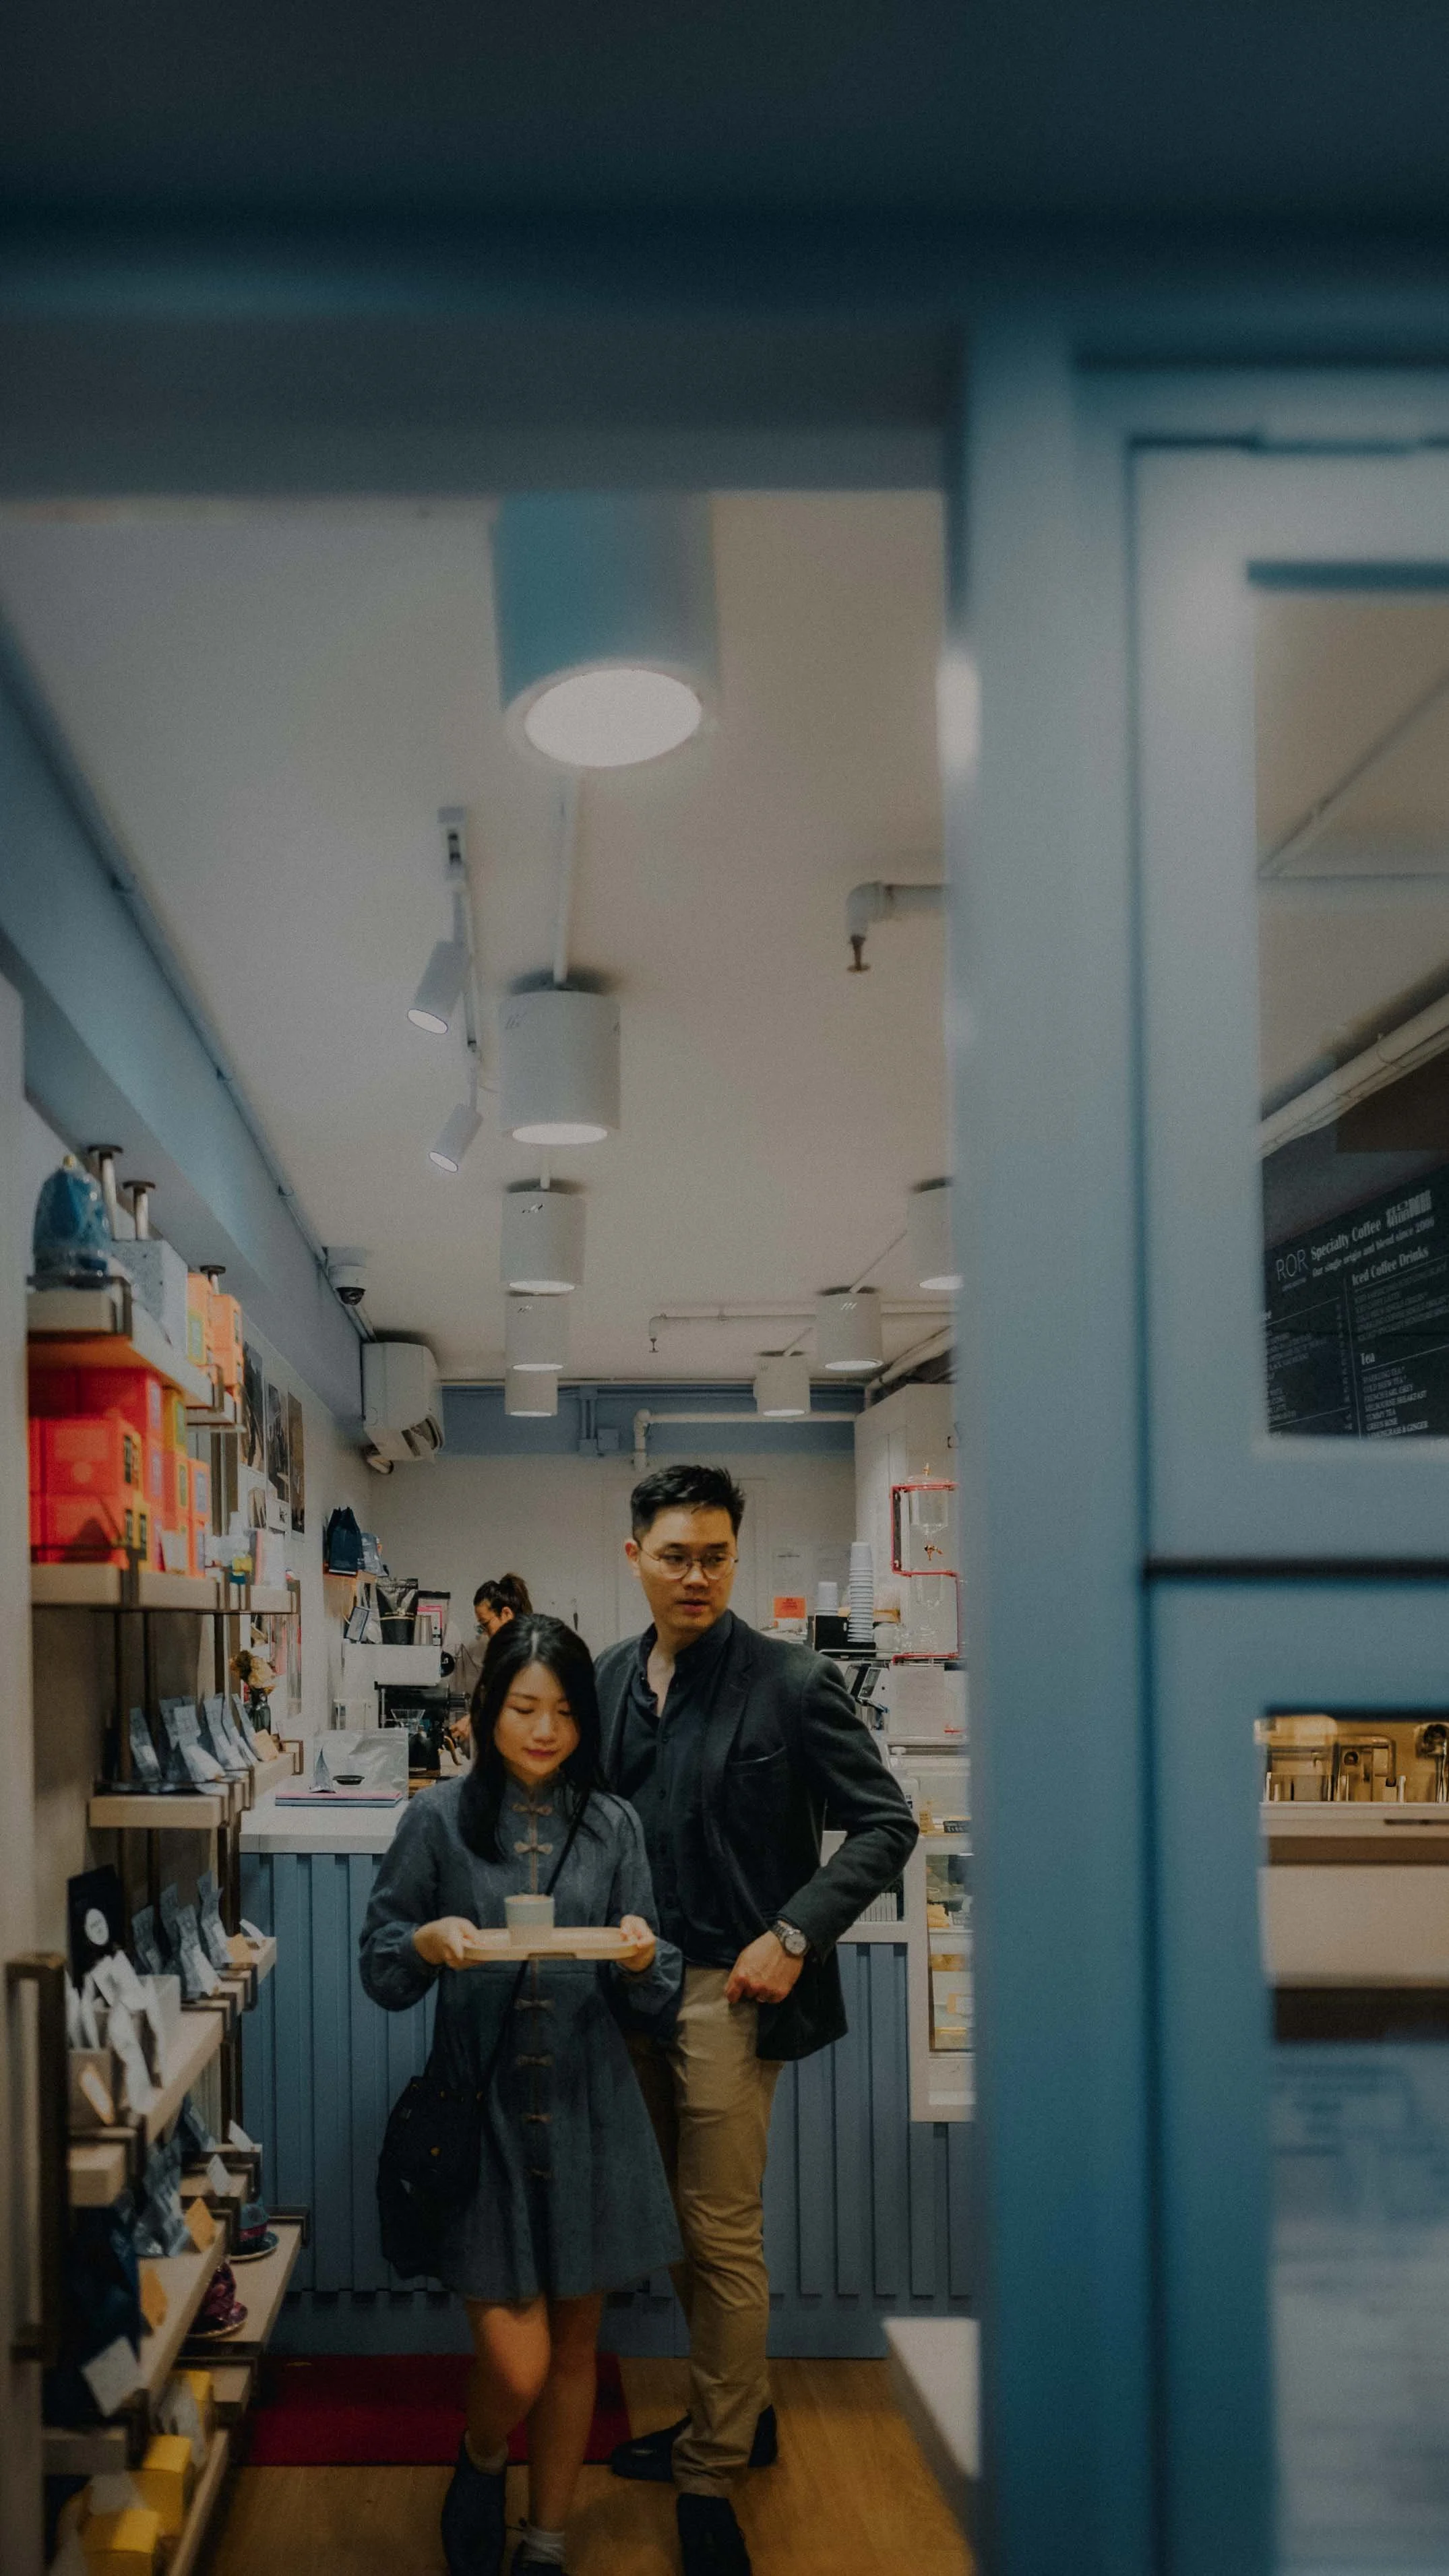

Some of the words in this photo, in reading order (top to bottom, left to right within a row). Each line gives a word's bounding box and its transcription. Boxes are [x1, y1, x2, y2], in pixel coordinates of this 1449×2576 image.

[1311, 1234, 1349, 1261] Specialty
[1352, 1219, 1382, 1242] Coffee
[1343, 1250, 1361, 1264] origin
[1363, 1243, 1375, 1256] and
[1376, 1234, 1394, 1250] blend
[1396, 1227, 1413, 1242] since
[1276, 1249, 1308, 1281] ROR
[1352, 1269, 1369, 1286] Iced
[1371, 1259, 1397, 1278] Coffee
[1399, 1246, 1429, 1267] Drinks
[1360, 1352, 1376, 1366] Tea
[1396, 1390, 1427, 1404] BREAKFAST
[1407, 1420, 1429, 1431] GINGER
